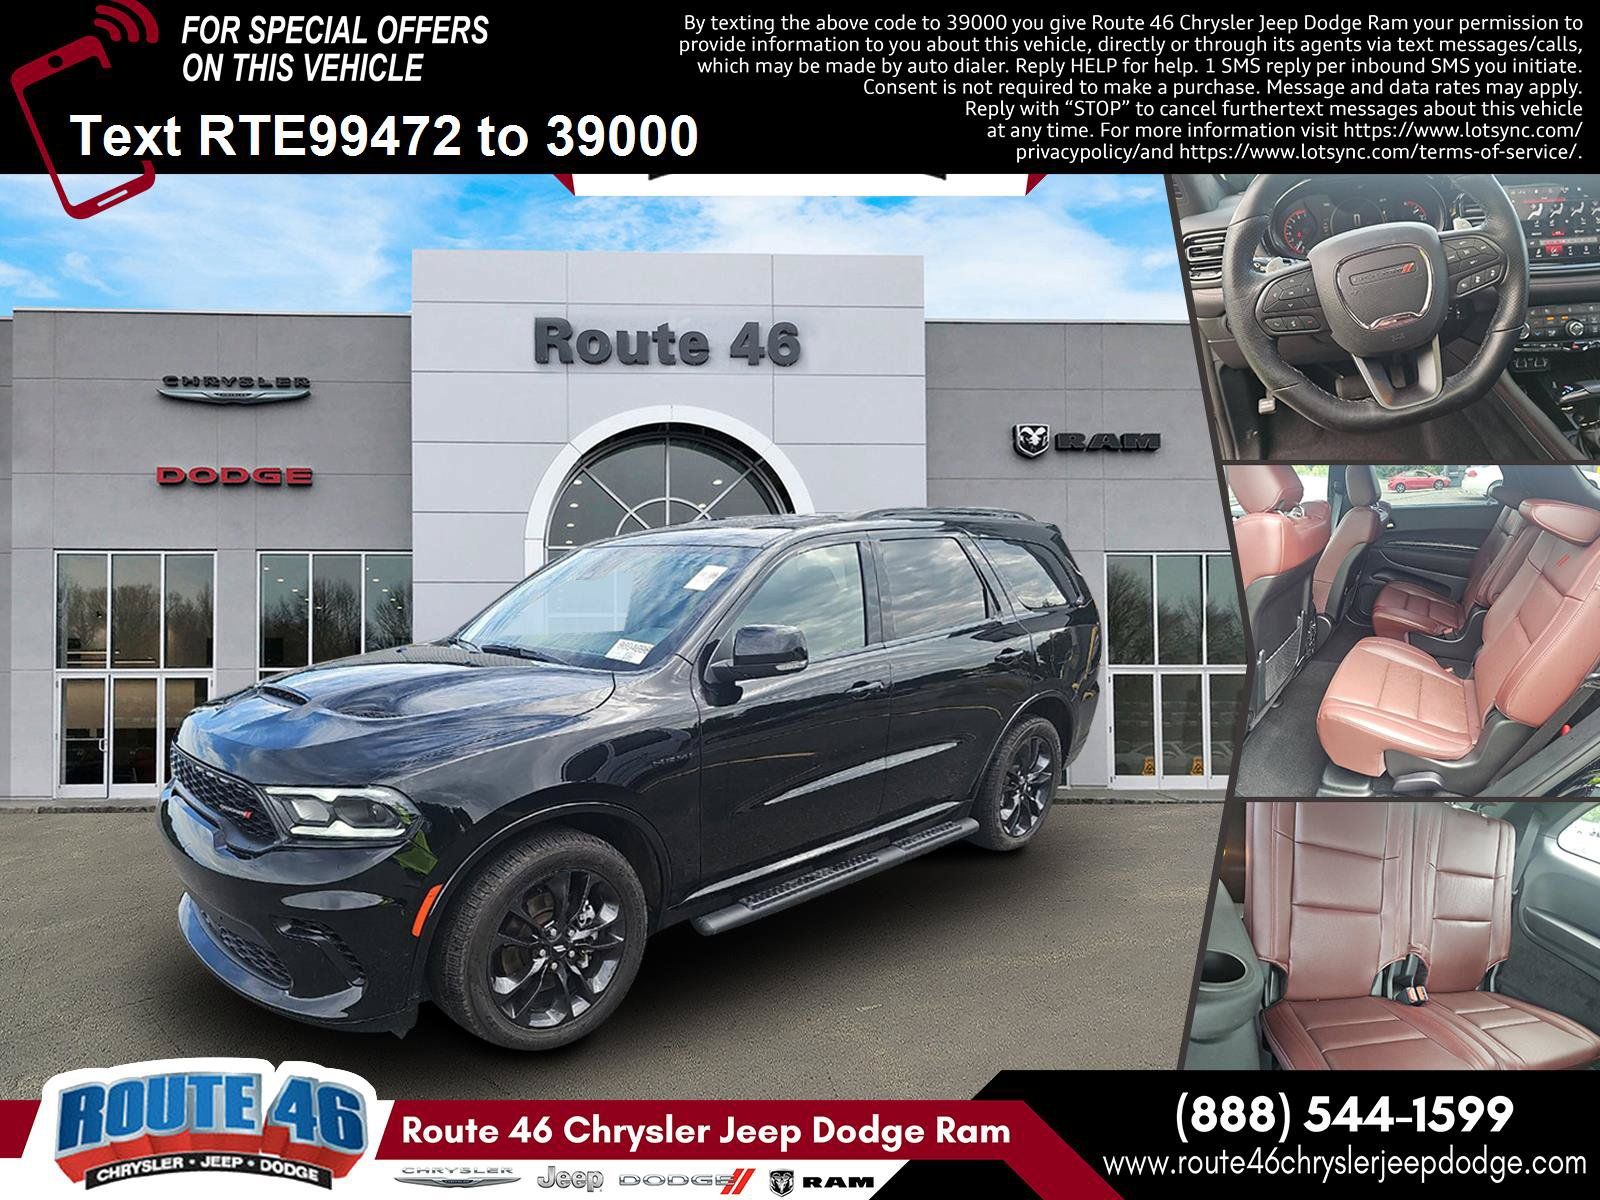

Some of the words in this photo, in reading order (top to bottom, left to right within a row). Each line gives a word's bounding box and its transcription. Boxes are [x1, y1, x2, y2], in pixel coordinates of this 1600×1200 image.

[534, 317, 711, 365] Route
[730, 322, 801, 367] 46
[162, 375, 311, 388] CHRYSLER
[1055, 433, 1161, 452] RAM
[156, 467, 313, 486] DODGE
